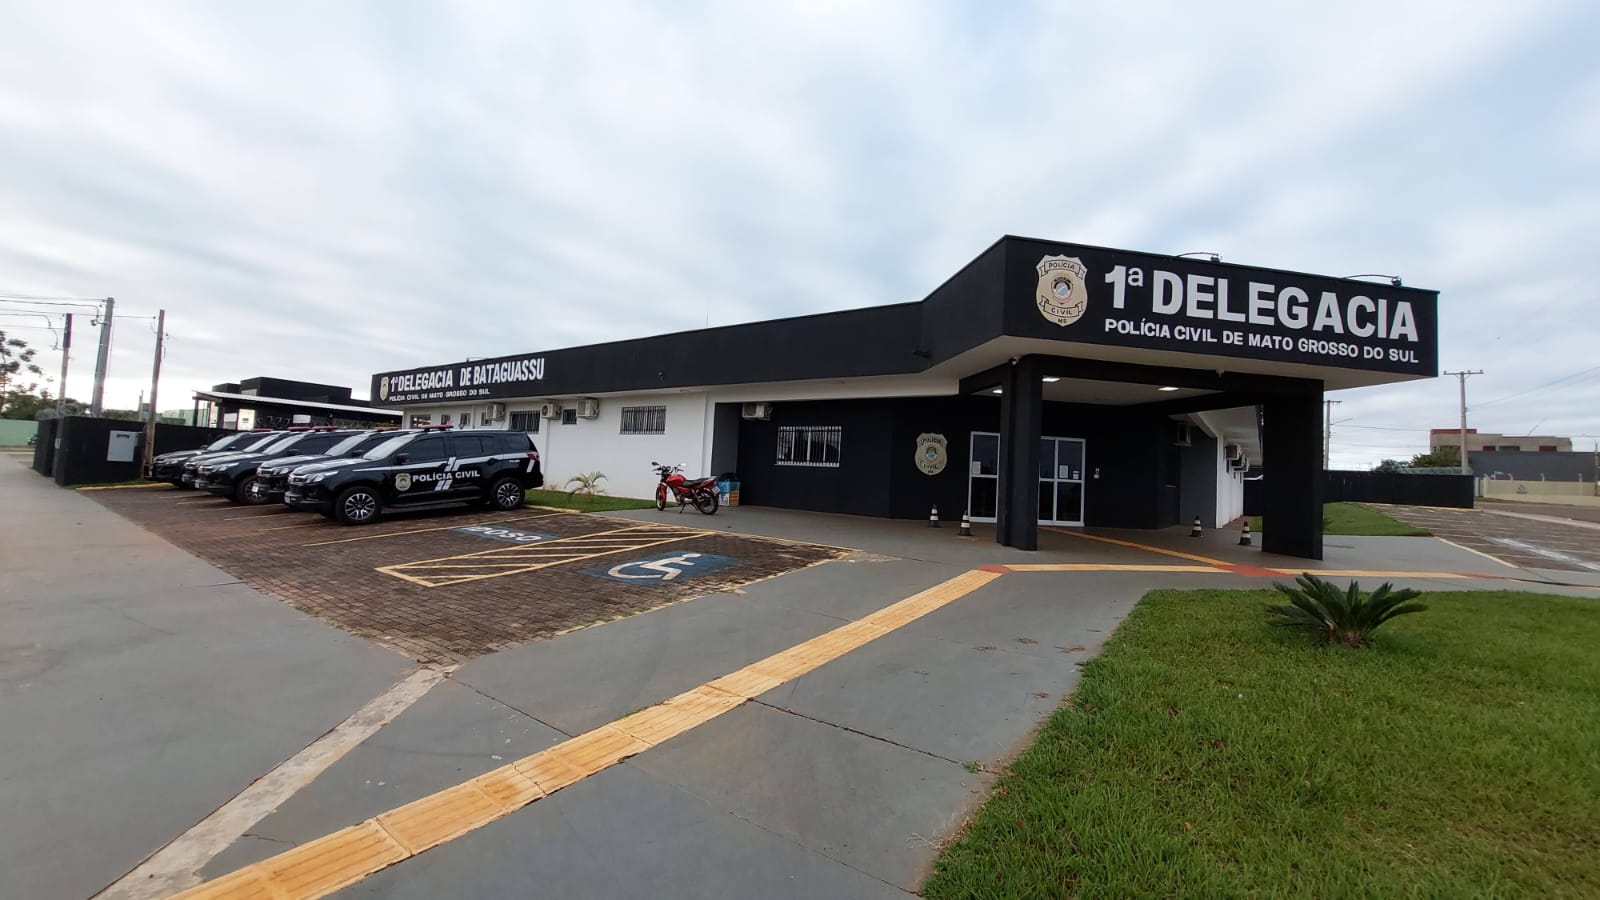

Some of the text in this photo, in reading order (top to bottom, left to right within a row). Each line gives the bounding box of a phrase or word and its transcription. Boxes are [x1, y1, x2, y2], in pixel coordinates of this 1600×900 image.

[1051, 307, 1072, 315] CIVIL
[1152, 270, 1419, 342] DELEGACIA
[1105, 317, 1419, 363] POLÍCIA CIVIL DE MATO GROSSO DO SUL
[398, 369, 453, 391] DELEGACIA
[460, 367, 472, 386] DE
[473, 358, 545, 385] BATAGUASSU
[445, 389, 467, 397] GROSSO
[412, 471, 453, 482] POLÍCIA
[455, 470, 480, 479] CIVIL
